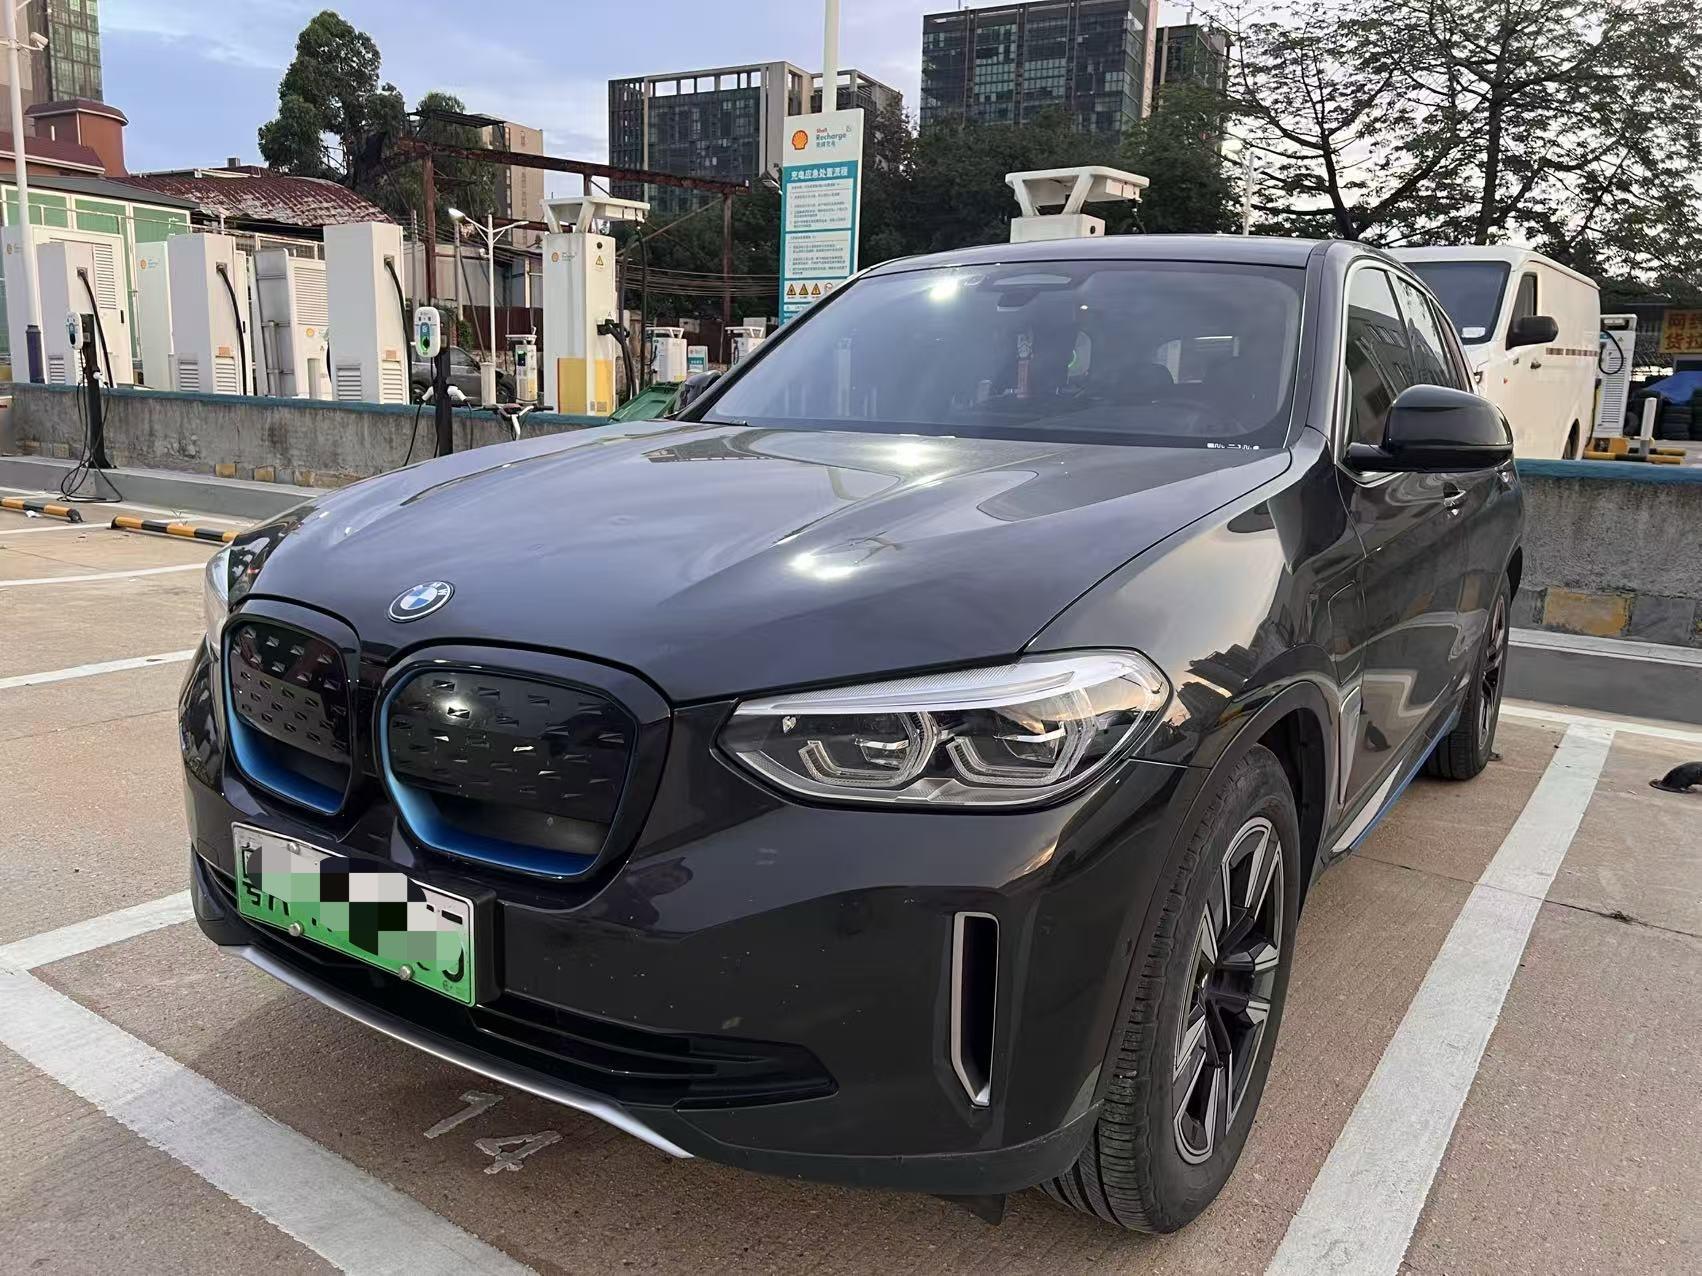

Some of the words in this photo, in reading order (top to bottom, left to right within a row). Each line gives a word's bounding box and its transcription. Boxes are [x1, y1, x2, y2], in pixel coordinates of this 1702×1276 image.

[815, 132, 847, 141] Recharge
[790, 167, 848, 180] 充电应急处置流程
